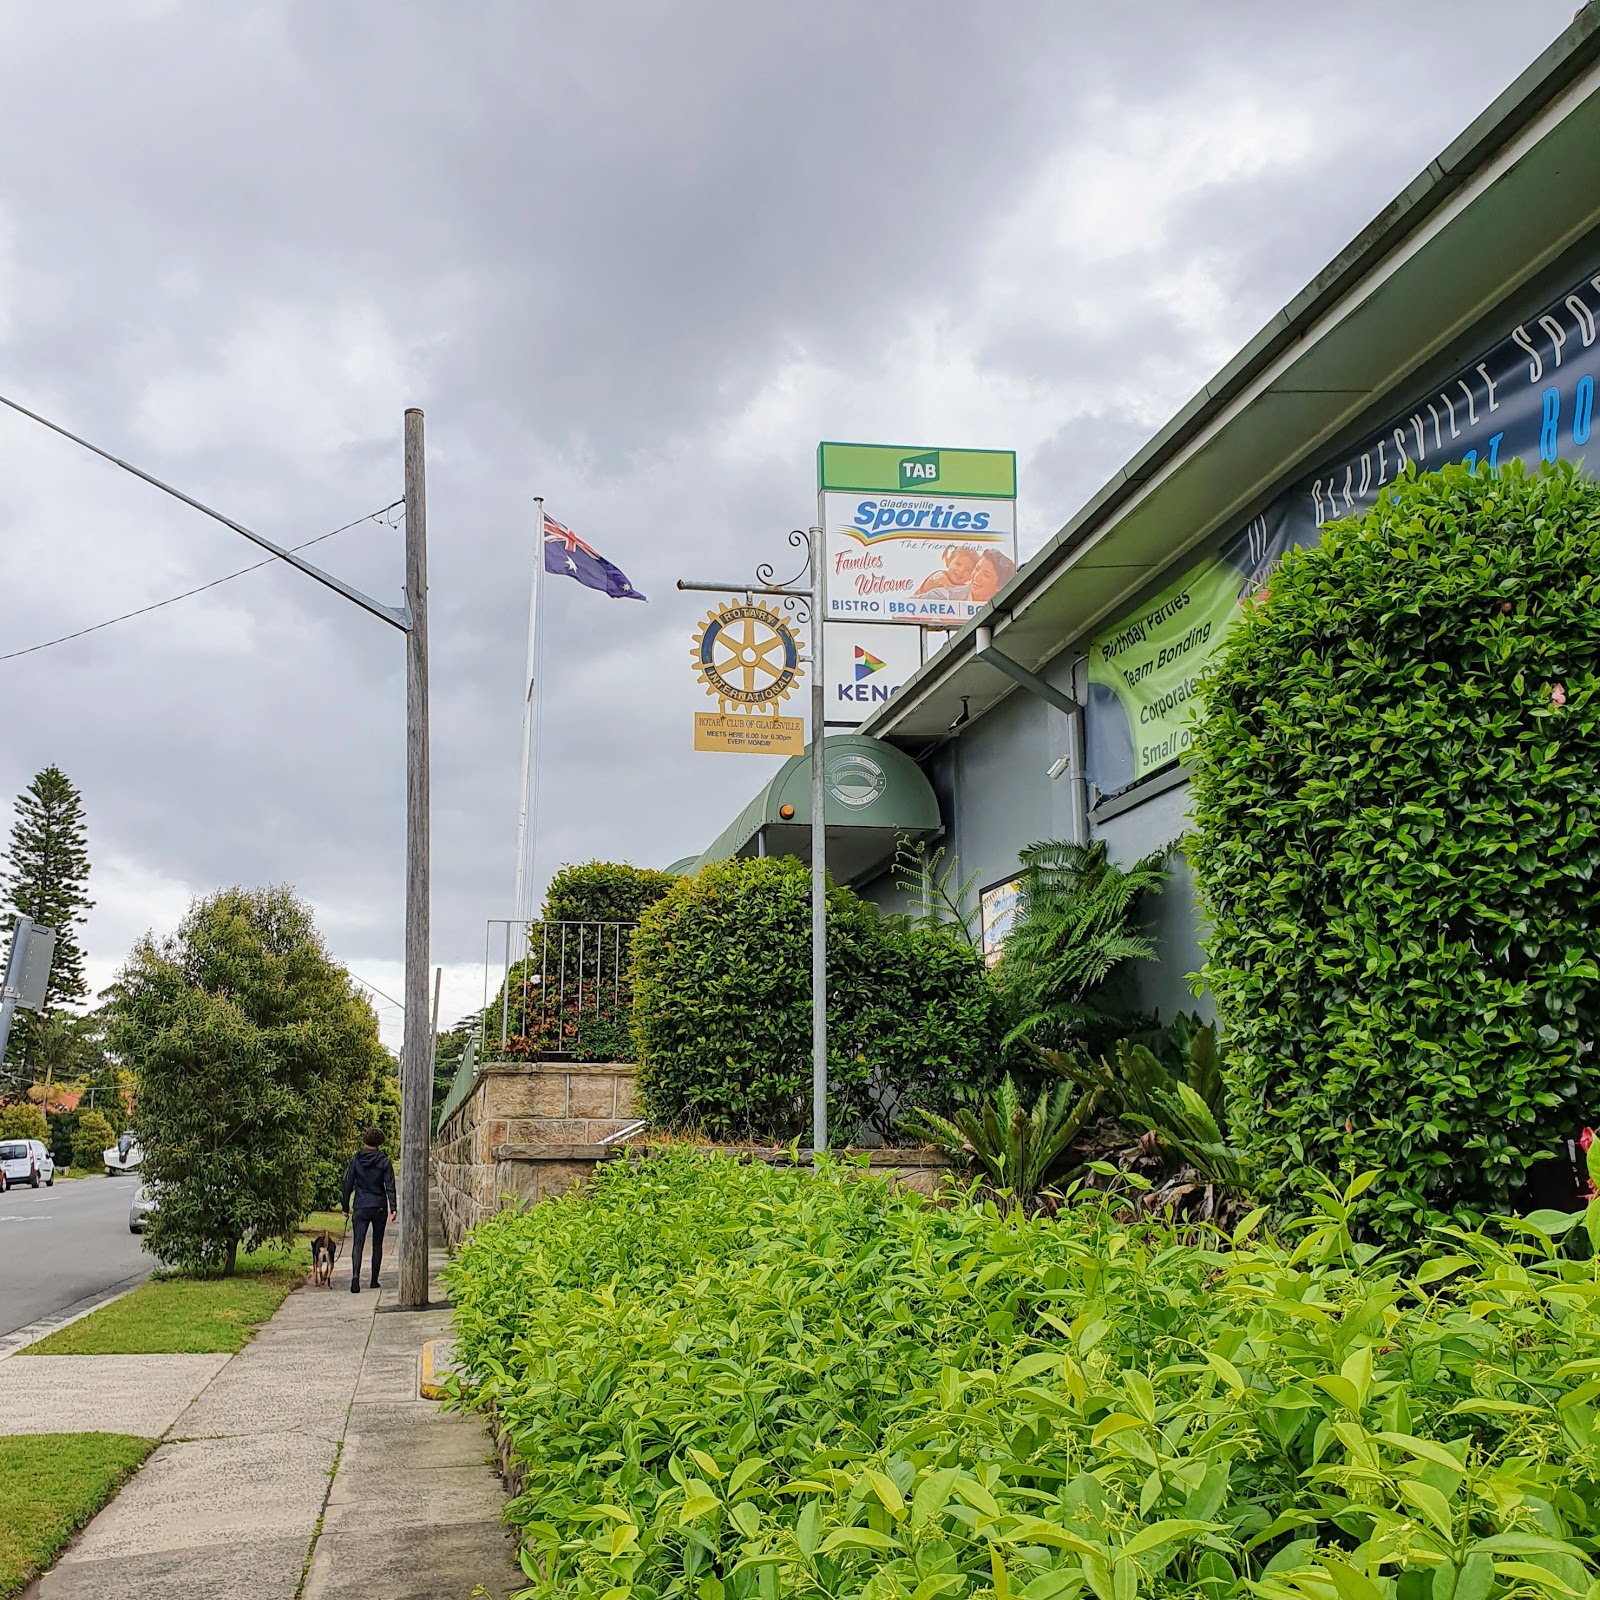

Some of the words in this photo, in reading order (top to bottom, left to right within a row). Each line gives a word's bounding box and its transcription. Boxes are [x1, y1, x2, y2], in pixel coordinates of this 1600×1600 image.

[1311, 363, 1500, 528] GLADESVILLE
[902, 463, 936, 478] TAB
[853, 501, 990, 531] Sporties
[879, 499, 934, 510] Gladesville
[900, 540, 917, 549] The
[834, 550, 883, 575] Families
[854, 573, 914, 596] Welcome
[723, 608, 775, 623] ROTARY
[832, 600, 880, 612] BISTRO
[889, 602, 916, 615] BBQ
[920, 603, 956, 615] AREA
[1102, 621, 1147, 662] Birthday
[1123, 659, 1154, 689] Team
[1157, 621, 1212, 669] Bonding
[707, 671, 791, 702] INTERNATIONAL
[1140, 676, 1198, 725] Corporate
[698, 718, 725, 727] ROTARY
[726, 719, 745, 728] CLUB
[746, 720, 755, 729] OF
[756, 720, 801, 731] GLADESVILLE
[1142, 731, 1178, 766] Small
